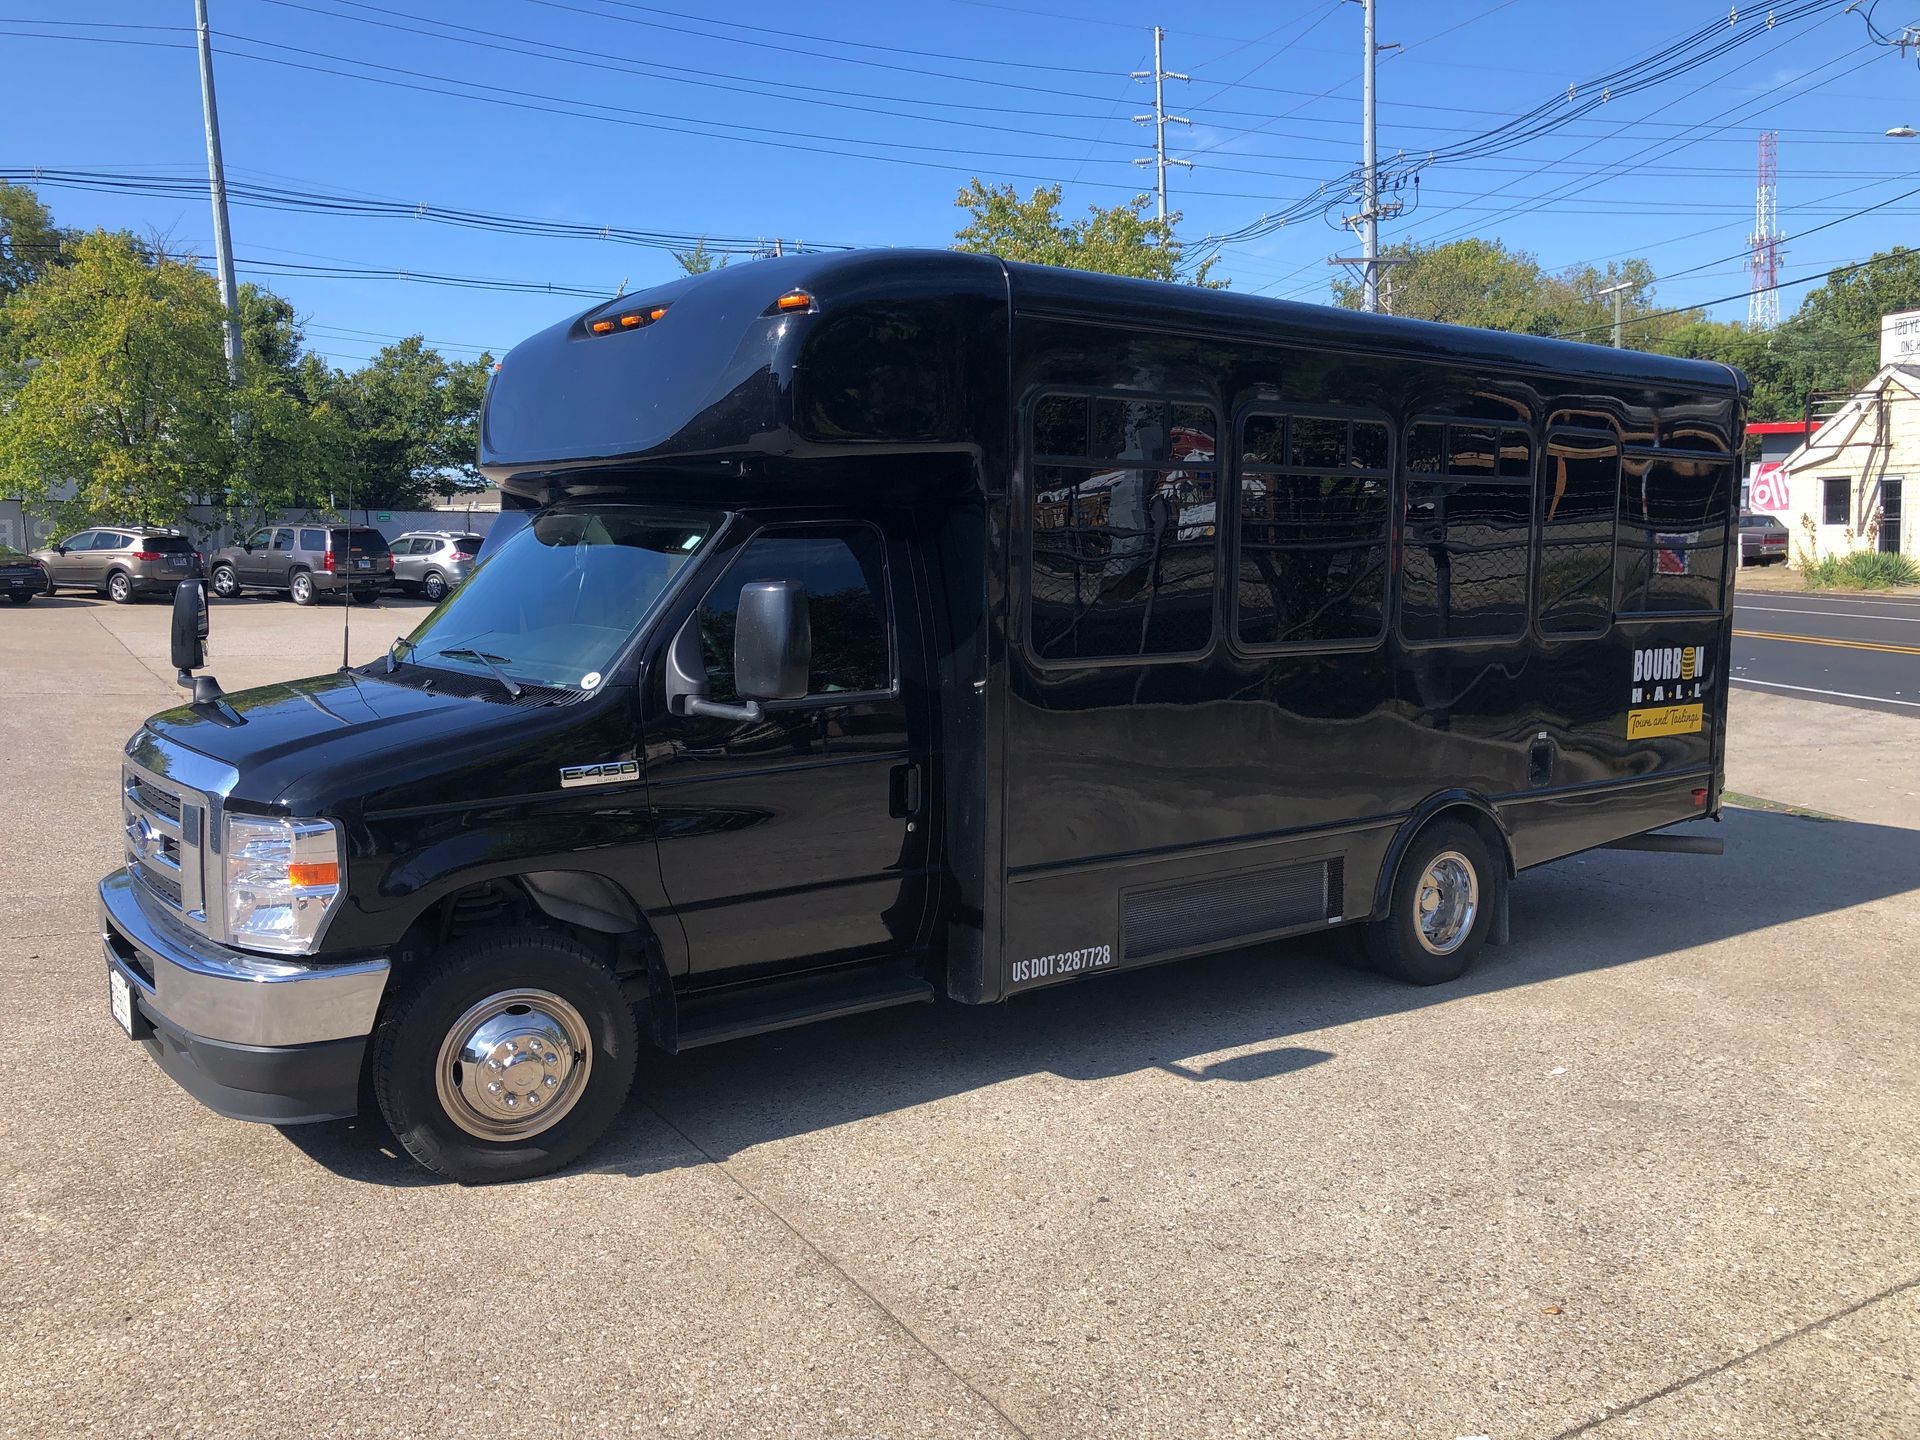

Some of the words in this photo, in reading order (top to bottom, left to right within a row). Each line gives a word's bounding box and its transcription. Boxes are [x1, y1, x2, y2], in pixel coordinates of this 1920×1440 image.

[1633, 646, 1704, 682] BOURBON
[1653, 709, 1669, 726] and
[1669, 708, 1699, 729] Tastings
